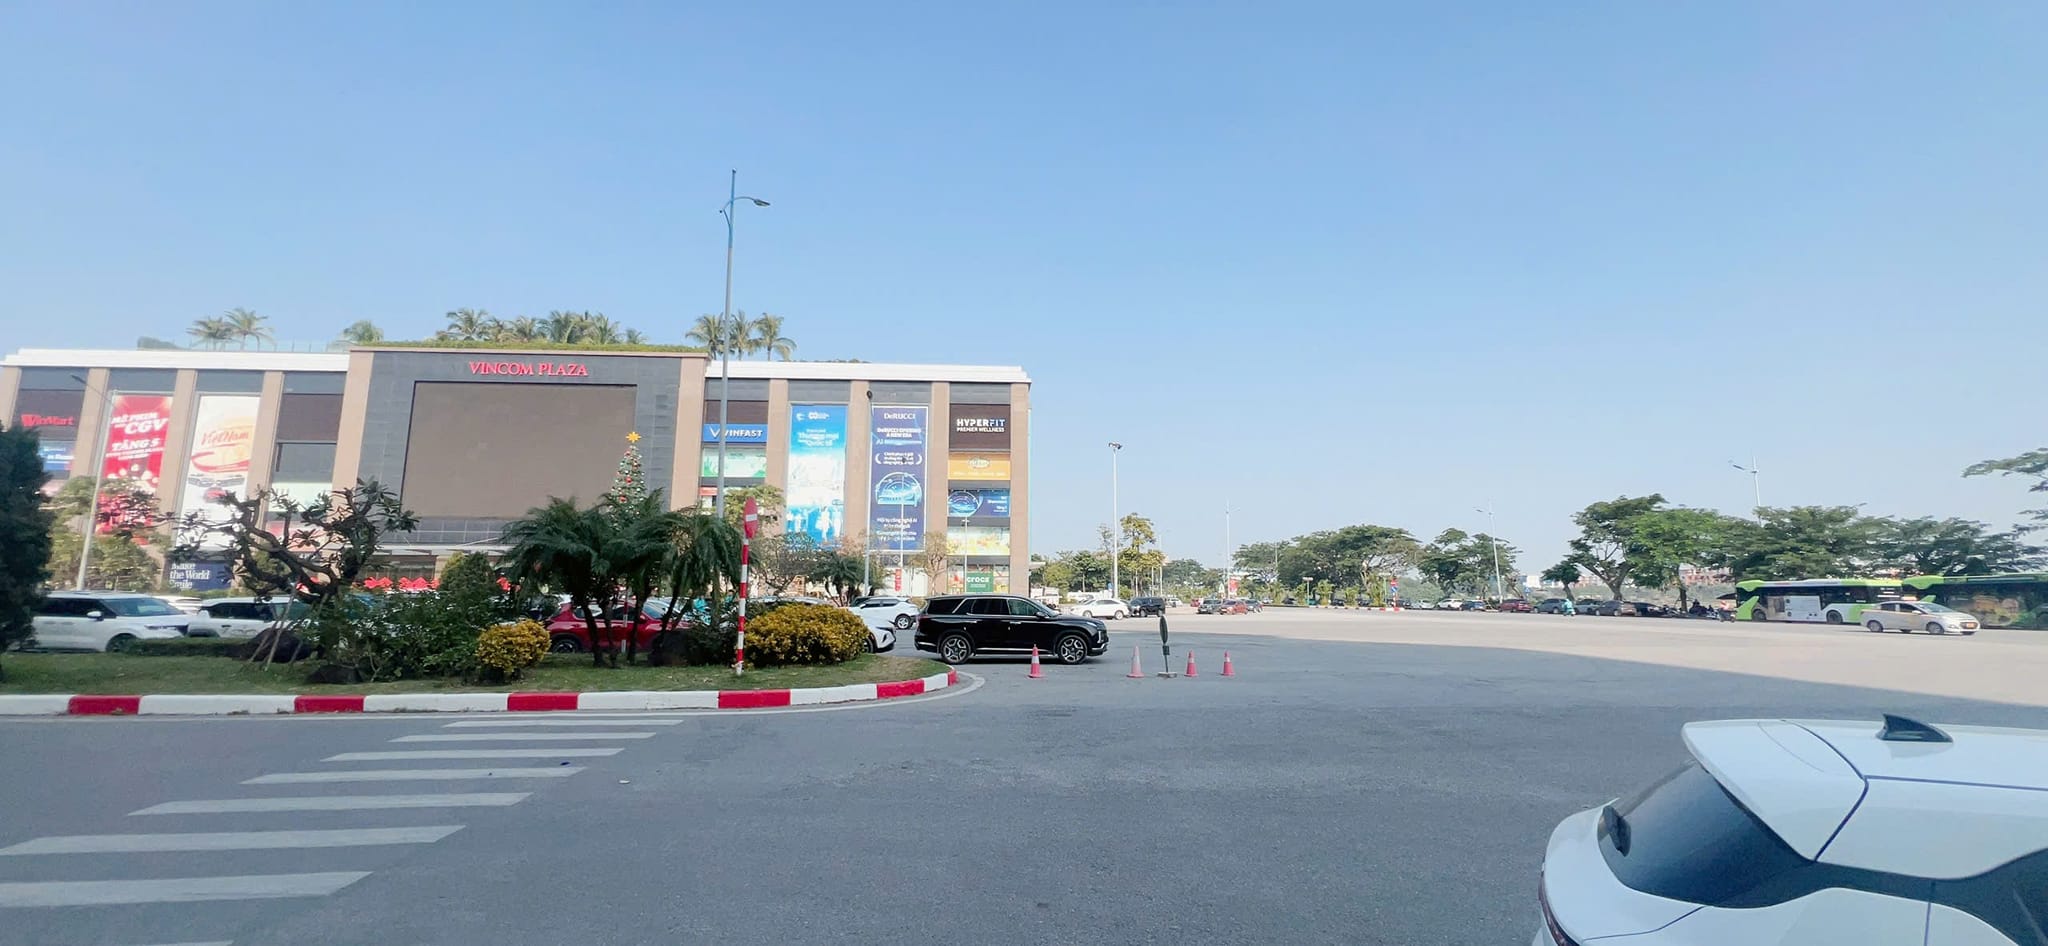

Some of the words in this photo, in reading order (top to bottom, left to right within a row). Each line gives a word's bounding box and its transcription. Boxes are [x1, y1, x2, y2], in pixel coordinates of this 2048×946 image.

[469, 361, 534, 376] VINCOM
[538, 362, 588, 377] PLAZA
[20, 413, 74, 427] WinMart
[124, 417, 168, 434] CGV
[956, 418, 1005, 427] HYPERFIT
[169, 569, 185, 579] the
[185, 569, 210, 580] World
